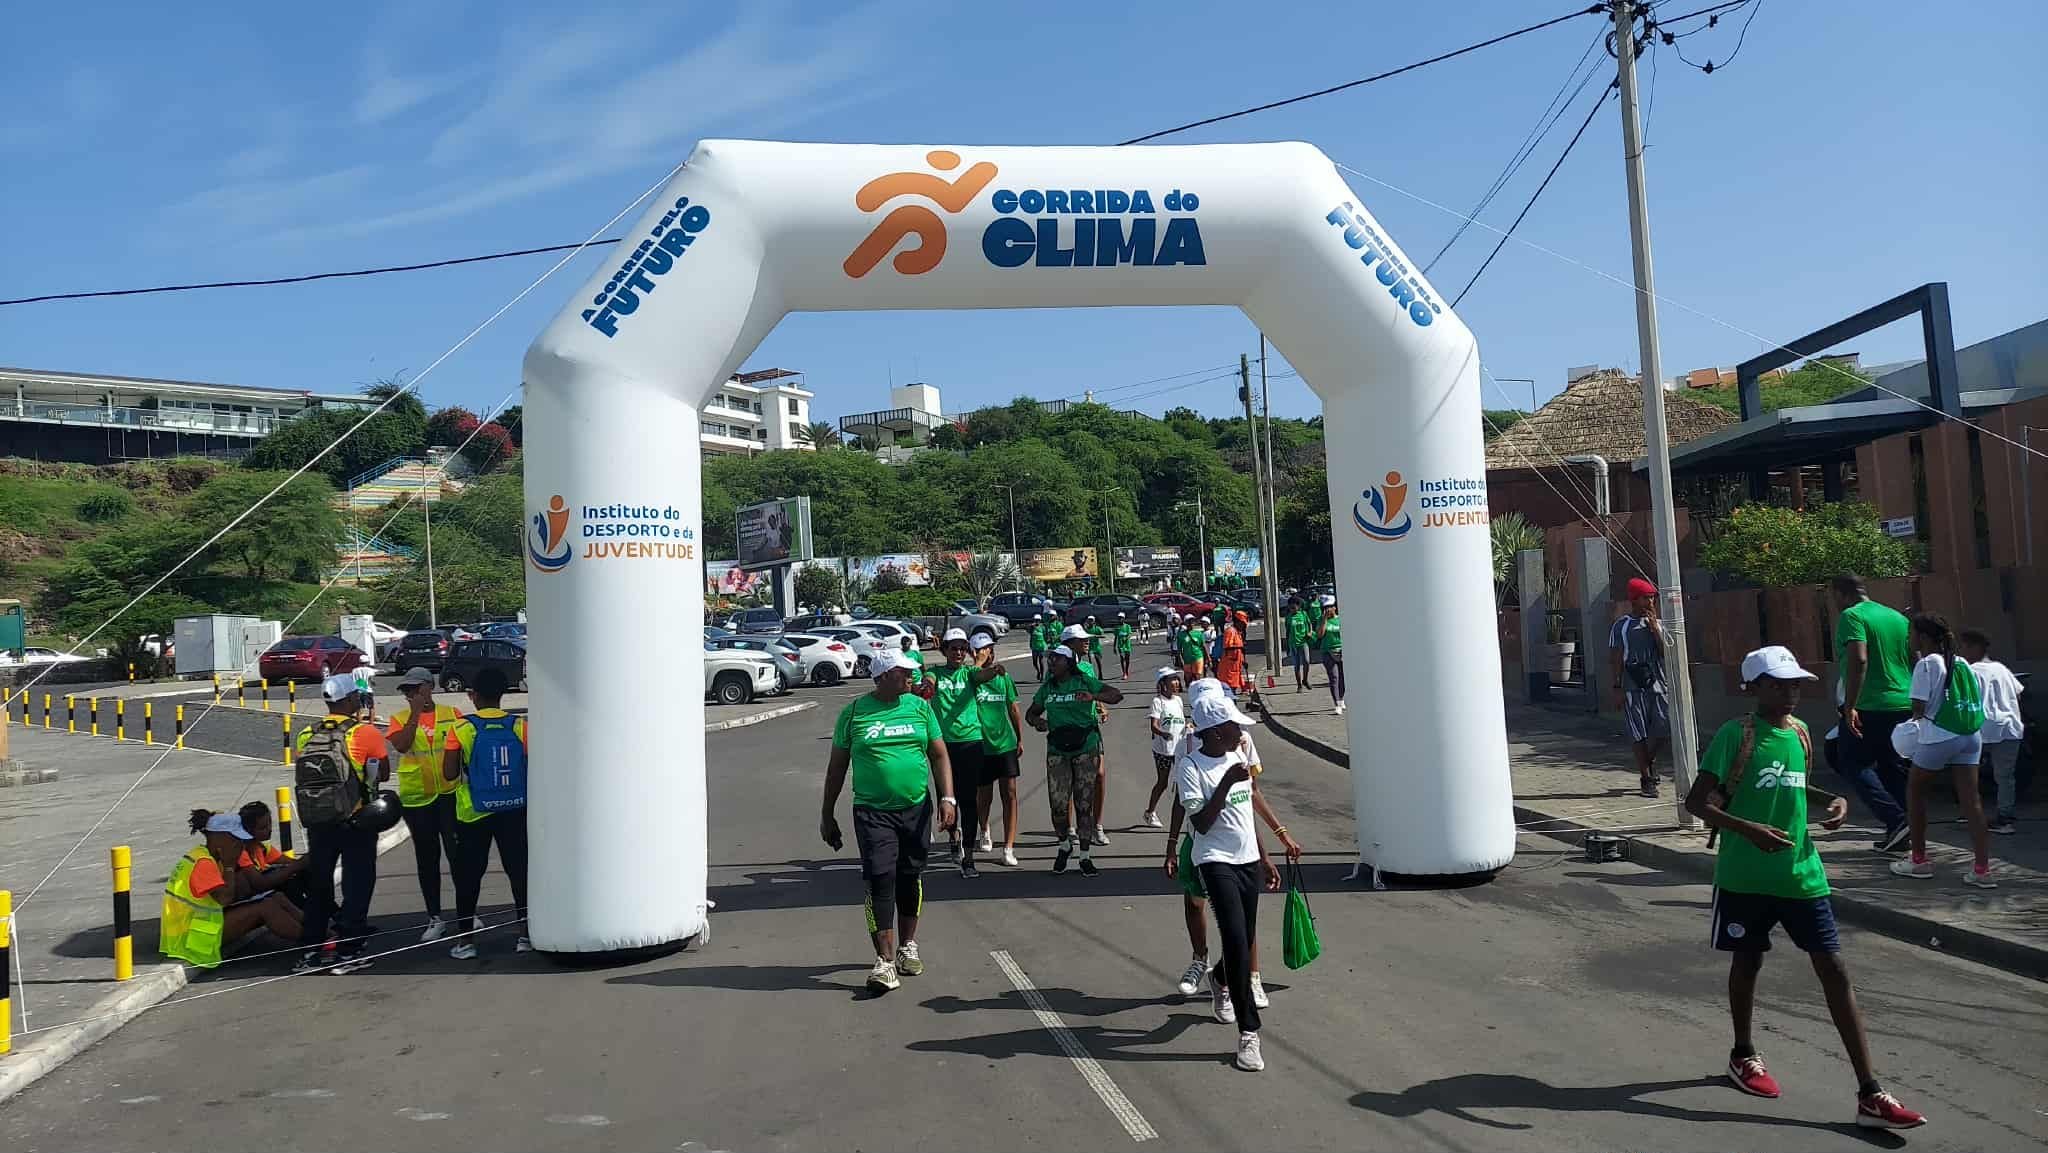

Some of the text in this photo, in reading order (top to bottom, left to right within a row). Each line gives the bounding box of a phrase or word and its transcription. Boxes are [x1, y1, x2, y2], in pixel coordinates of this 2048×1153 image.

[992, 189, 1200, 214] CORRIDA do
[982, 217, 1208, 268] CLIMA
[581, 196, 690, 323] A CORRER PELO
[1325, 205, 1434, 328] FUTURO
[590, 205, 711, 339] FUTURO
[1420, 477, 1477, 492] Instituto
[1421, 494, 1483, 509] DESPORTO
[583, 504, 680, 520] Instituto do
[1422, 511, 1489, 528] JUVENTU
[583, 524, 693, 539] DESPORTO e da
[583, 542, 694, 560] JUVENTUDE
